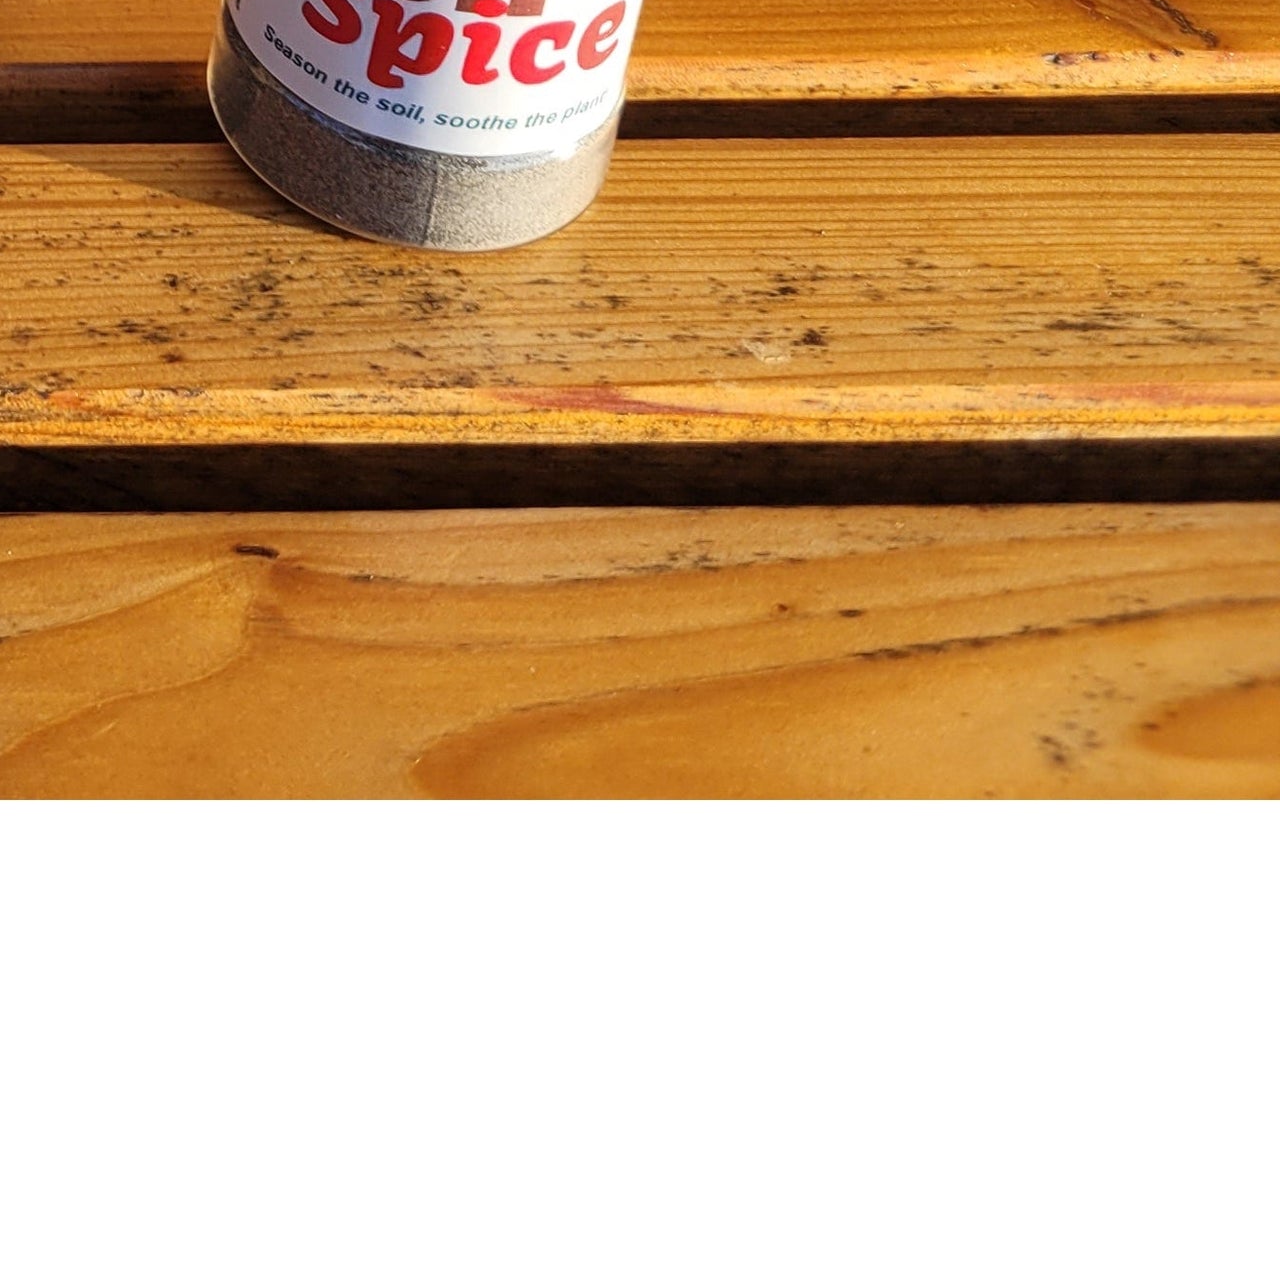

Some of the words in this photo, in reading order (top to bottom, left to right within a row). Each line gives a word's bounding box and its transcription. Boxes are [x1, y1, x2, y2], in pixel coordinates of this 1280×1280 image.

[264, 24, 328, 84] Season
[333, 78, 370, 105] the
[375, 100, 426, 124] soil,
[433, 113, 518, 130] soothe
[524, 111, 558, 129] the
